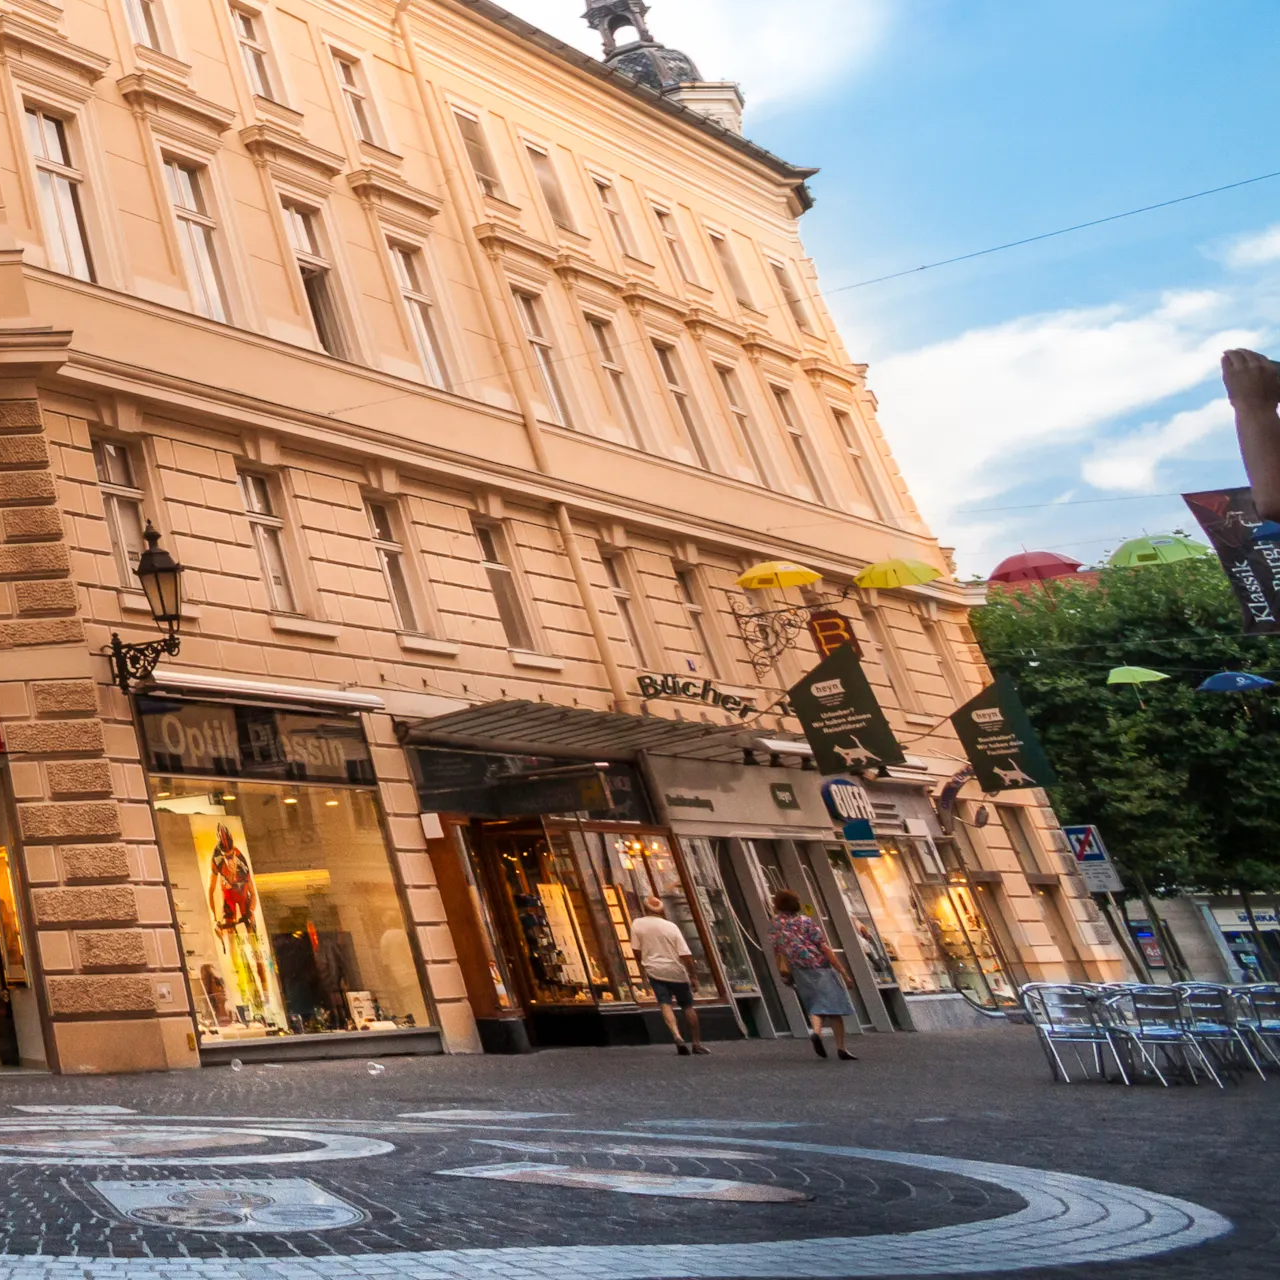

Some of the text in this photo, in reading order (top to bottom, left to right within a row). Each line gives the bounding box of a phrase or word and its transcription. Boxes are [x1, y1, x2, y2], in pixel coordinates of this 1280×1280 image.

[1232, 559, 1276, 623] Klassik
[637, 673, 754, 718] Bücher
[815, 683, 839, 694] heyn
[825, 718, 846, 726] haben
[976, 711, 998, 720] heyn
[161, 714, 345, 767] Optik Plessin
